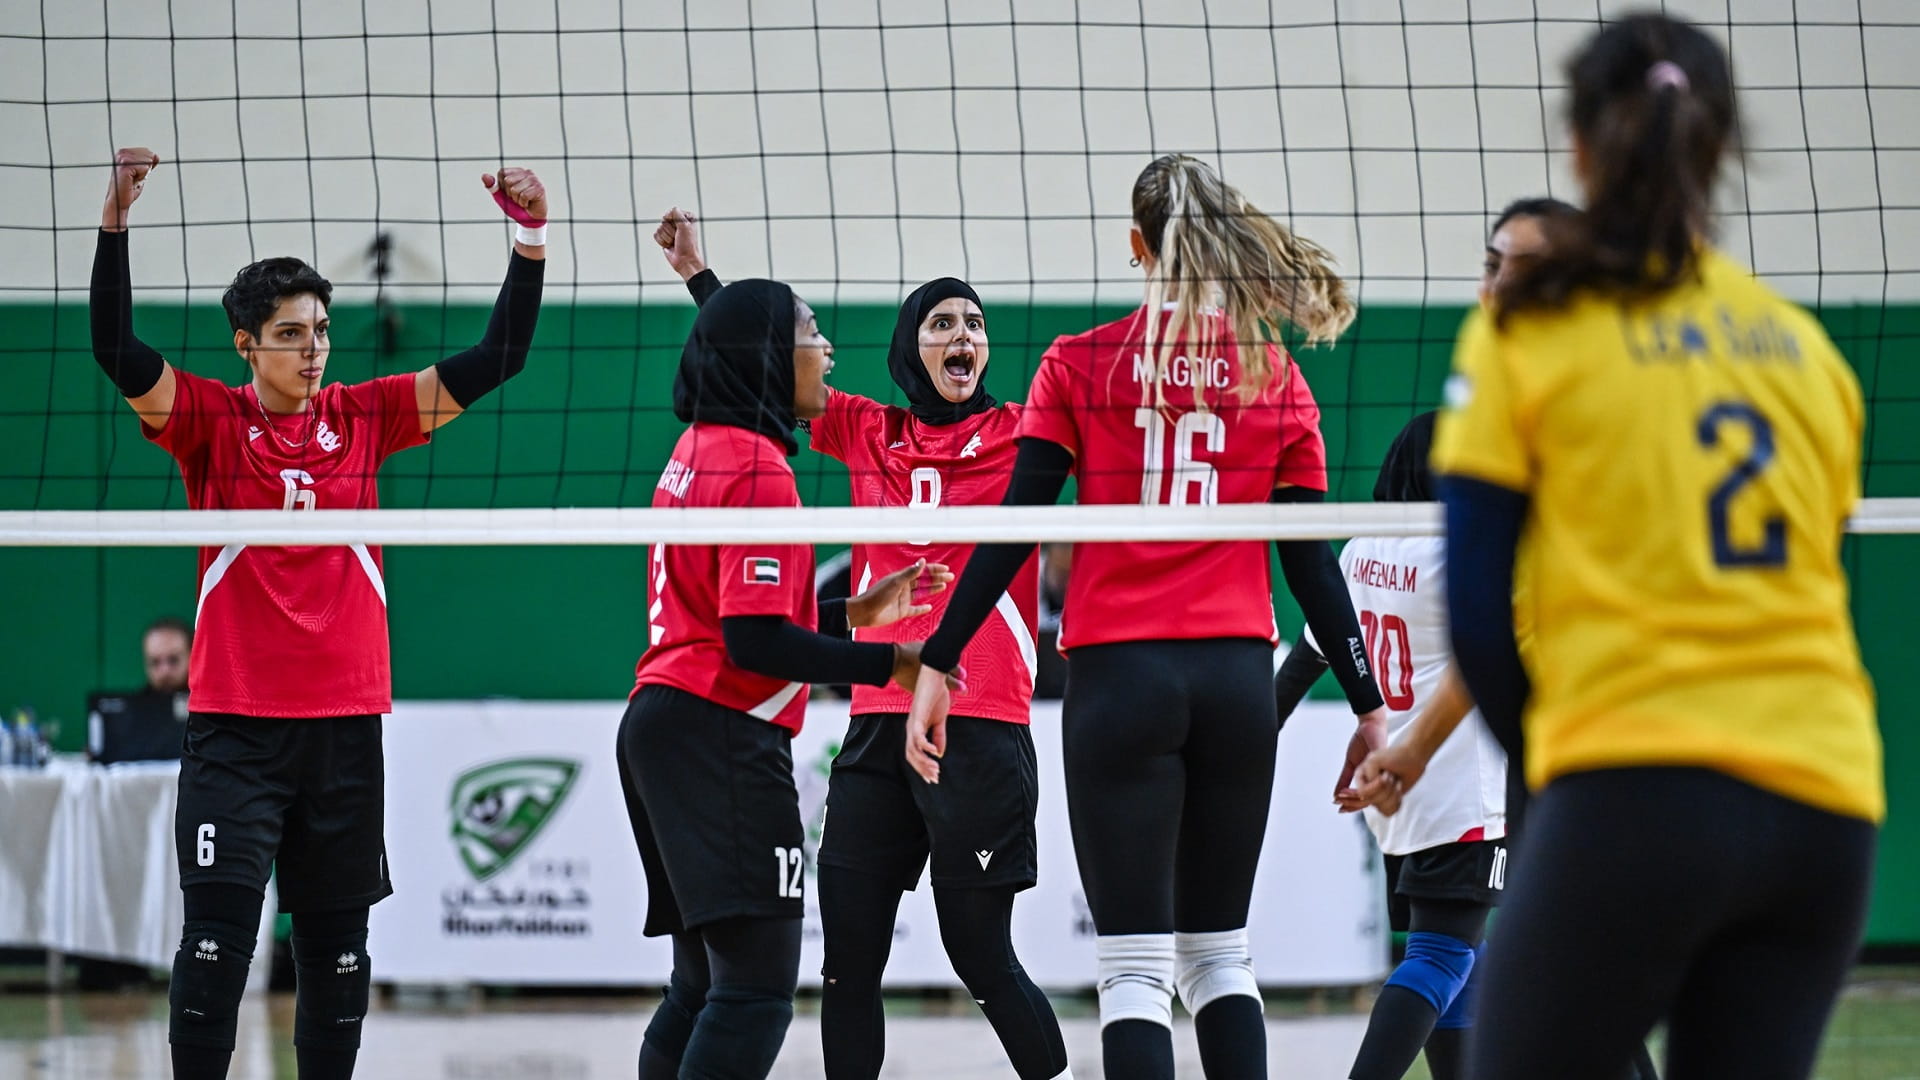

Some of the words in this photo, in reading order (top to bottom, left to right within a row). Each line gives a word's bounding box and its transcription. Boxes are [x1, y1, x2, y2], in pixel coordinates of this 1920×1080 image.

[1134, 407, 1226, 506] 16
[1694, 399, 1789, 572] 2
[1353, 558, 1418, 594] AMEENA.M
[1347, 636, 1370, 679] ALLSIX
[1359, 609, 1415, 712] 10
[197, 823, 216, 867] 6
[1488, 846, 1507, 891] 10
[774, 846, 803, 898] 12
